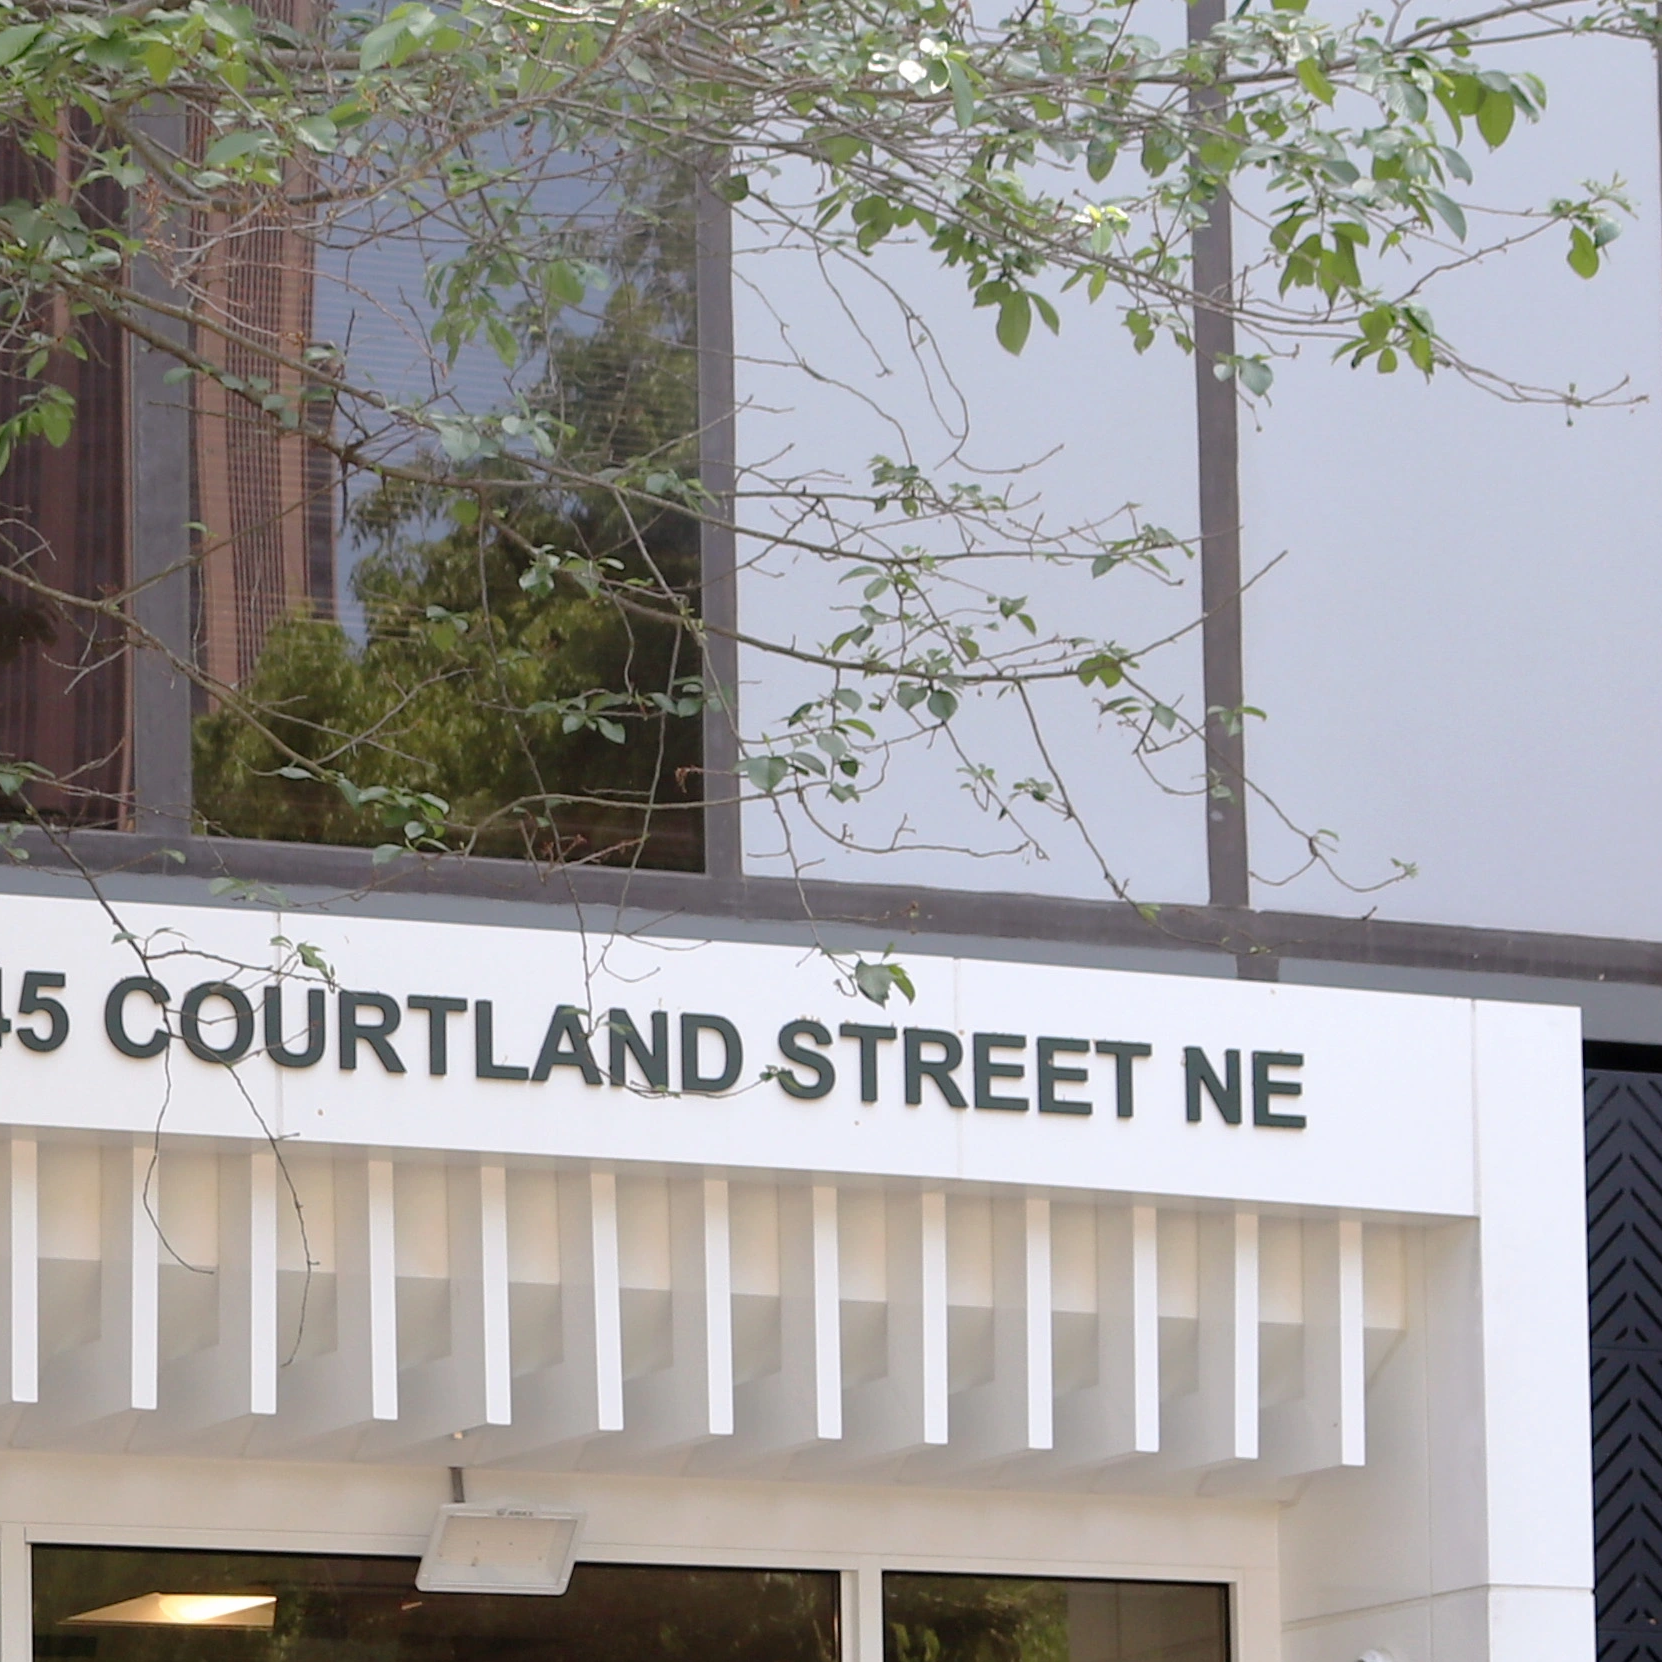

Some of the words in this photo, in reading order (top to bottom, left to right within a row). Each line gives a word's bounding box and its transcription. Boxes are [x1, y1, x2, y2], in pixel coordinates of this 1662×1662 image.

[103, 974, 743, 1093] COURTLAND
[776, 1018, 1151, 1119] STREET
[1184, 1046, 1307, 1130] NE
